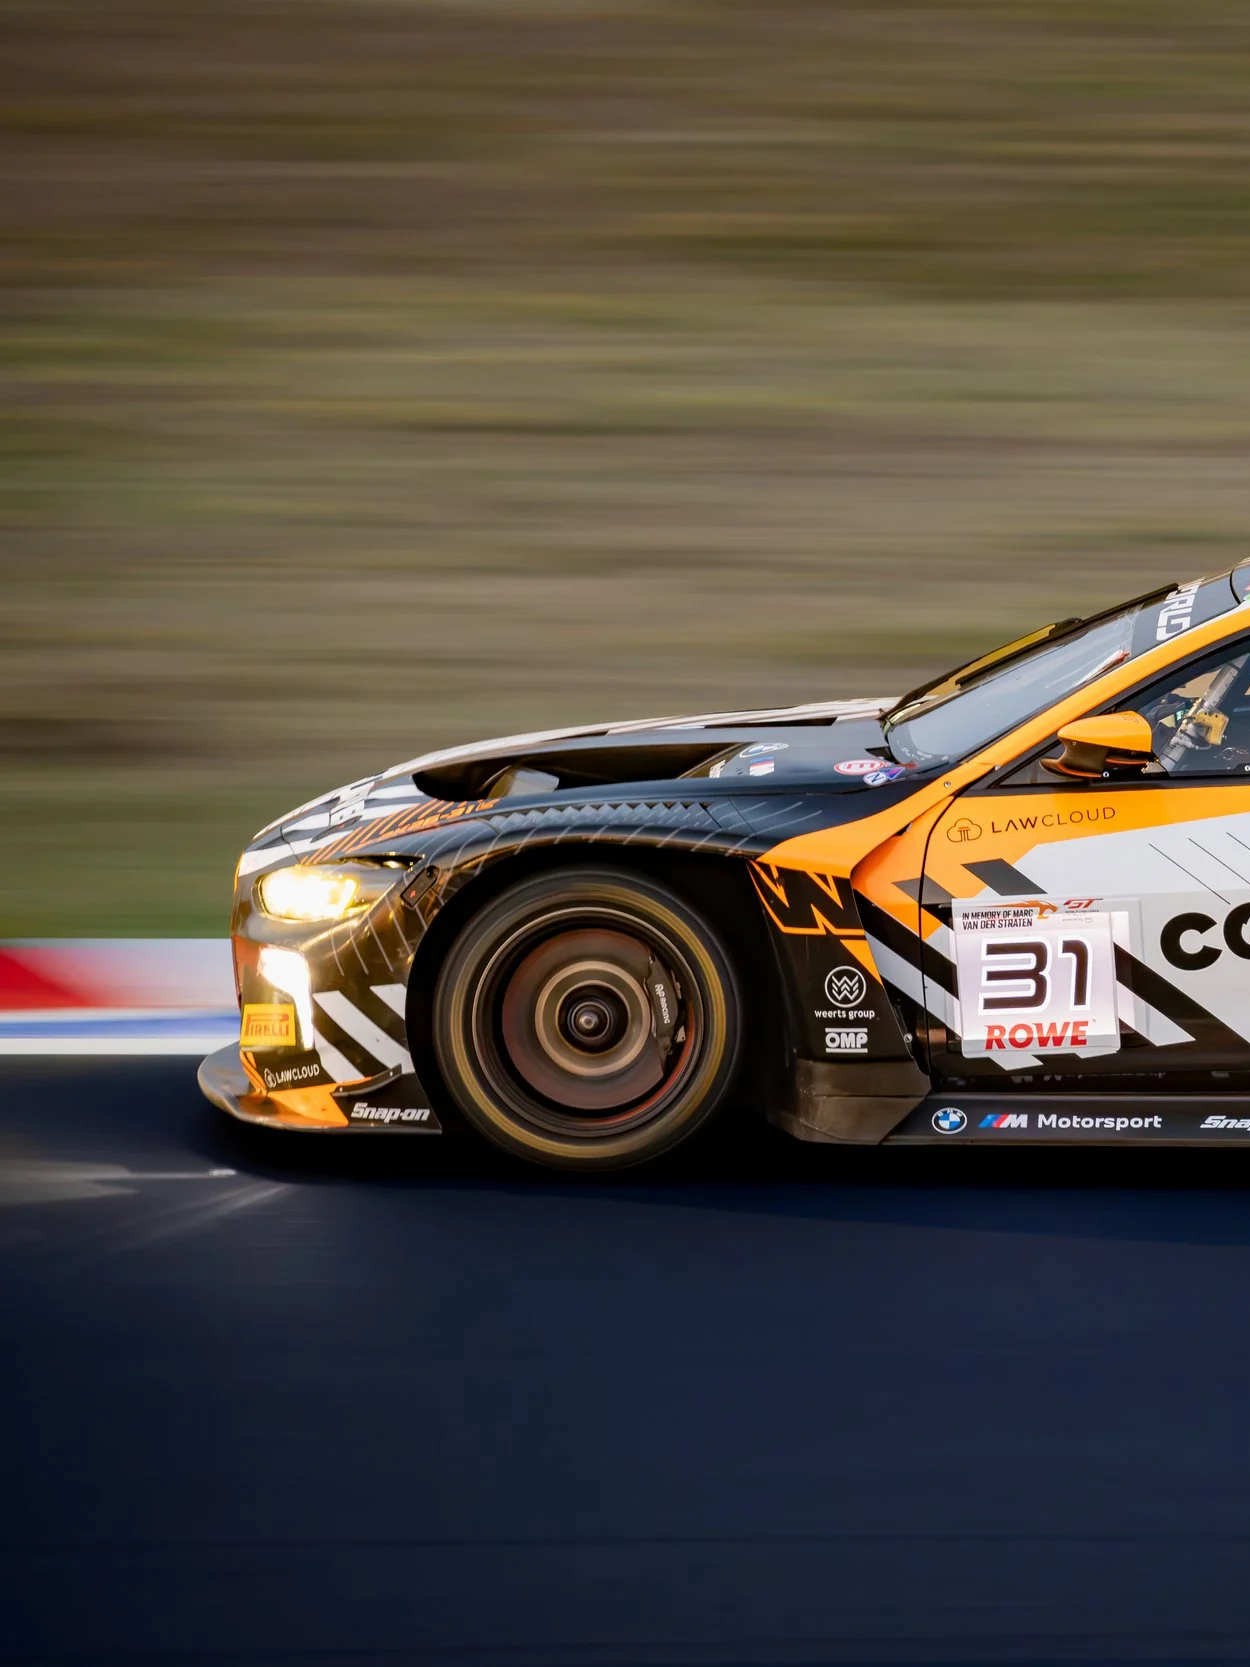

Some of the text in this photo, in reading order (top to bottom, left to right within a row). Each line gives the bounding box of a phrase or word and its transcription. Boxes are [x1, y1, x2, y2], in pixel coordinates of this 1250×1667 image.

[991, 806, 1116, 834] LAWCLOUD
[962, 909, 1034, 920] IN MEMORY OF MARC
[962, 918, 1033, 930] VAN DER STRATEN
[980, 936, 1091, 1013] 31
[244, 1012, 290, 1038] PIRELLI
[814, 1010, 876, 1020] weerts group
[825, 1032, 868, 1049] OMP
[984, 1020, 1089, 1050] ROWE
[275, 1063, 320, 1084] LAWCLOUD
[351, 1102, 430, 1124] Snap-on
[1038, 1113, 1163, 1131] Motorsport
